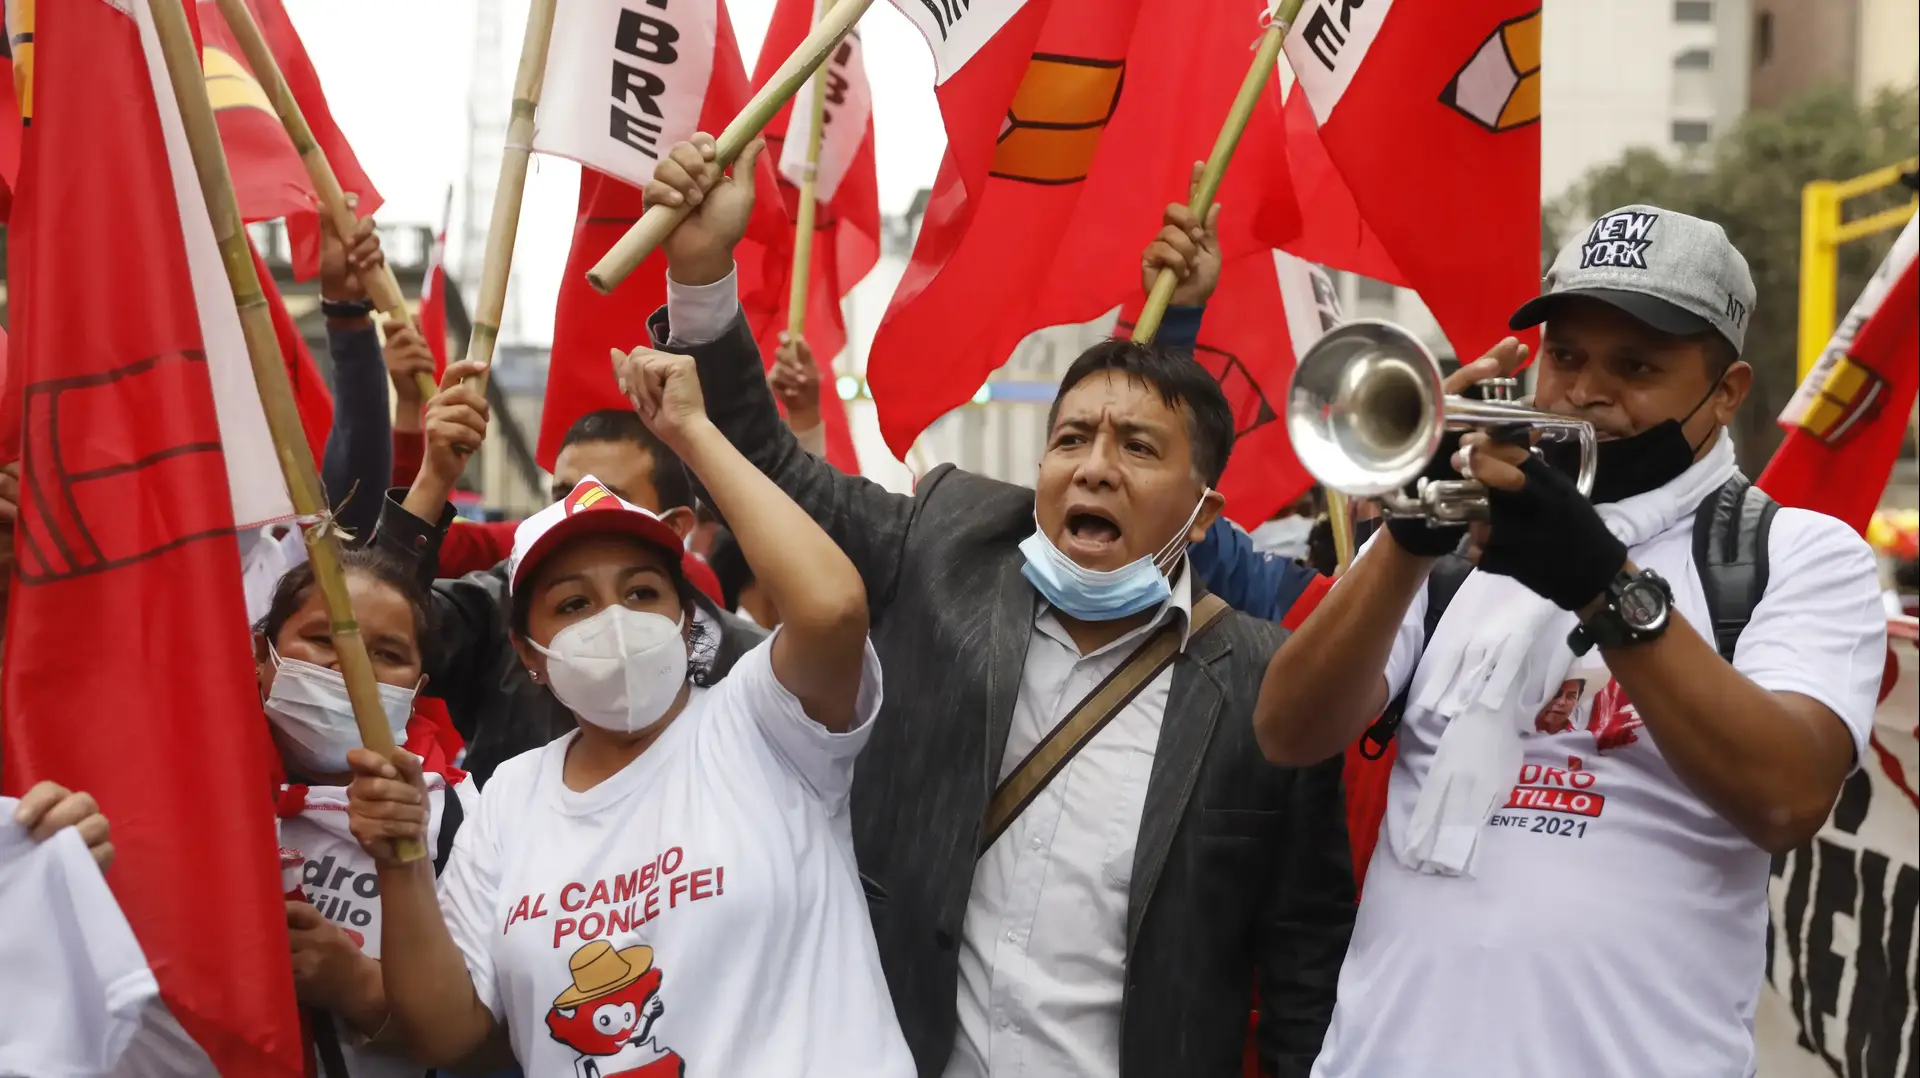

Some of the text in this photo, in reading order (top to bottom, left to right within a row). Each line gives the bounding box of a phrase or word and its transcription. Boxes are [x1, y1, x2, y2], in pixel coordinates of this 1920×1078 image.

[609, 0, 680, 160] BRE
[1587, 212, 1658, 243] NEW
[1580, 239, 1653, 269] YORK
[1726, 293, 1746, 329] NY
[1519, 763, 1596, 789] DRO
[1515, 788, 1592, 812] TILLO
[1489, 815, 1588, 839] ENTE 2021
[303, 855, 381, 899] dro
[559, 846, 683, 912] CAMBIO
[305, 892, 372, 927] tillo
[552, 866, 724, 949] PONLE FE!
